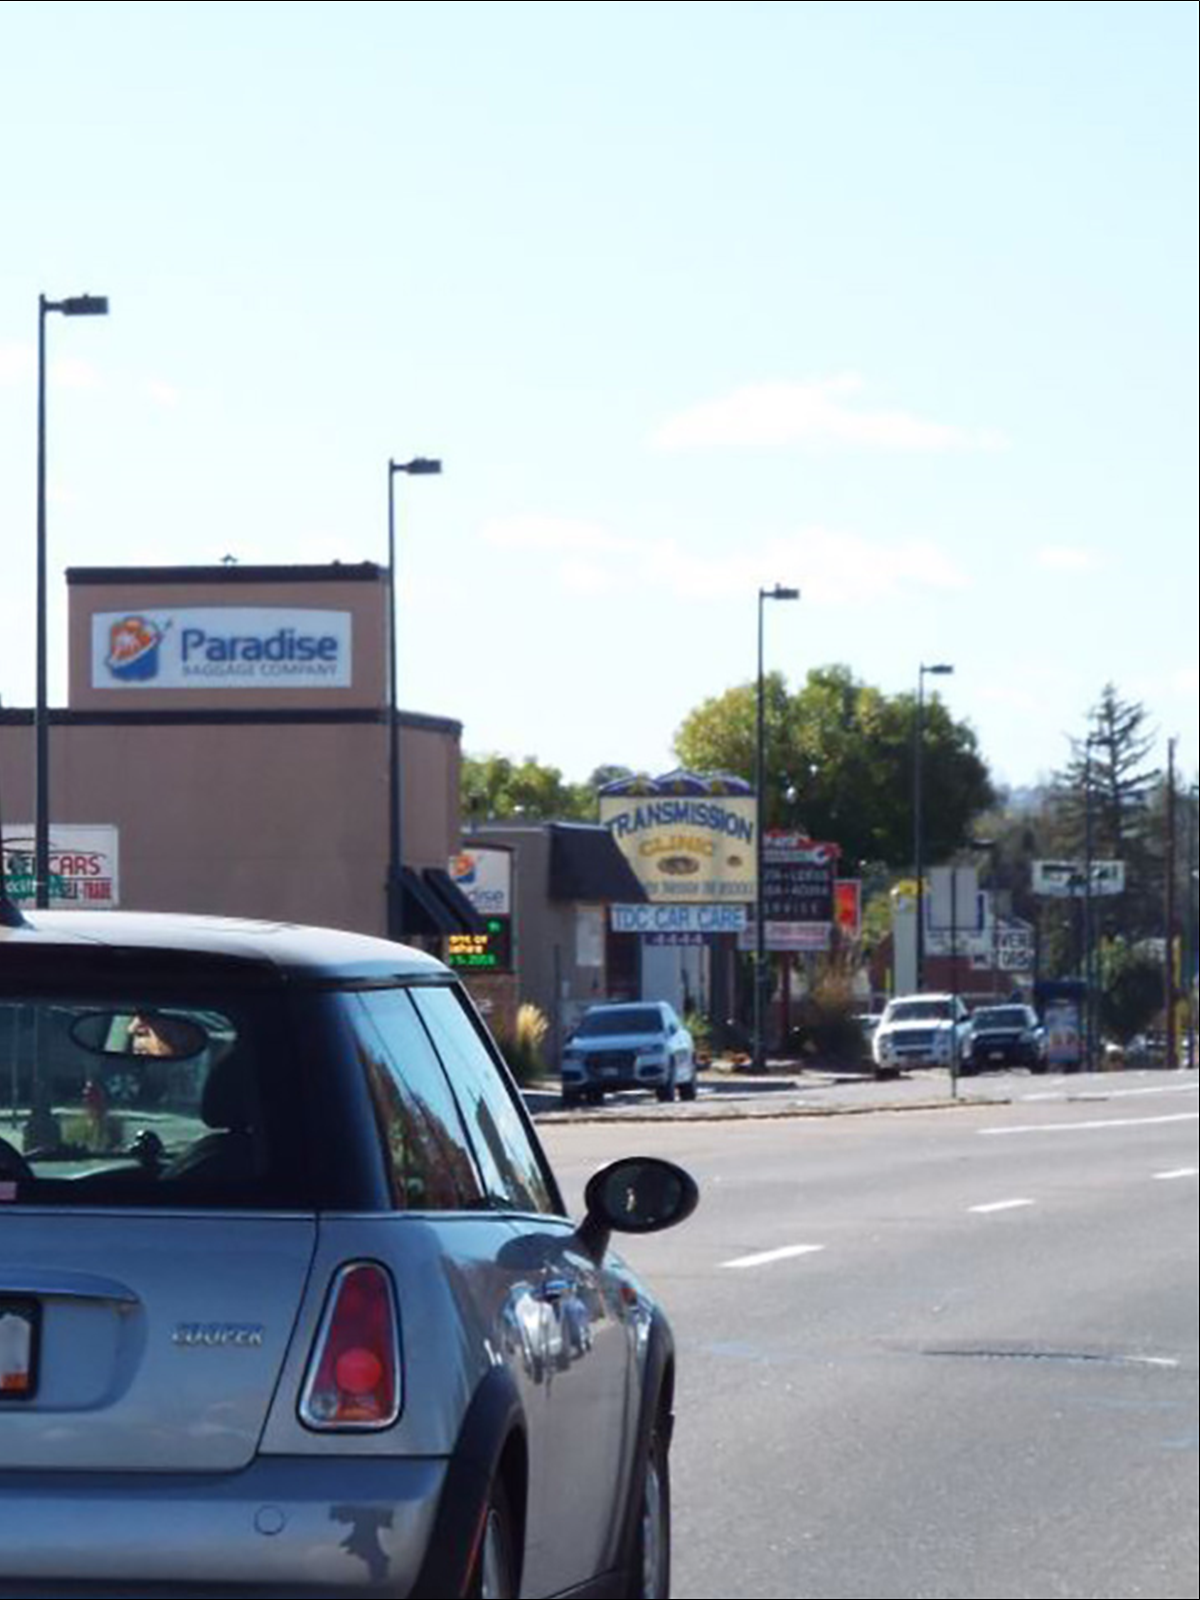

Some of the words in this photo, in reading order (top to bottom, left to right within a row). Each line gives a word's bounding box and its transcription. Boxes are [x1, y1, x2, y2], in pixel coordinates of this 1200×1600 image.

[181, 629, 338, 662] Paradise
[182, 663, 256, 677] BAGGAGE
[260, 663, 337, 677] COMPANY
[604, 801, 754, 844] TRANSMISSION
[638, 834, 714, 857] CLINIC
[614, 906, 648, 928] TDC
[655, 906, 689, 929] CAR
[697, 906, 743, 928] CARE
[170, 1325, 262, 1346] COOPER
